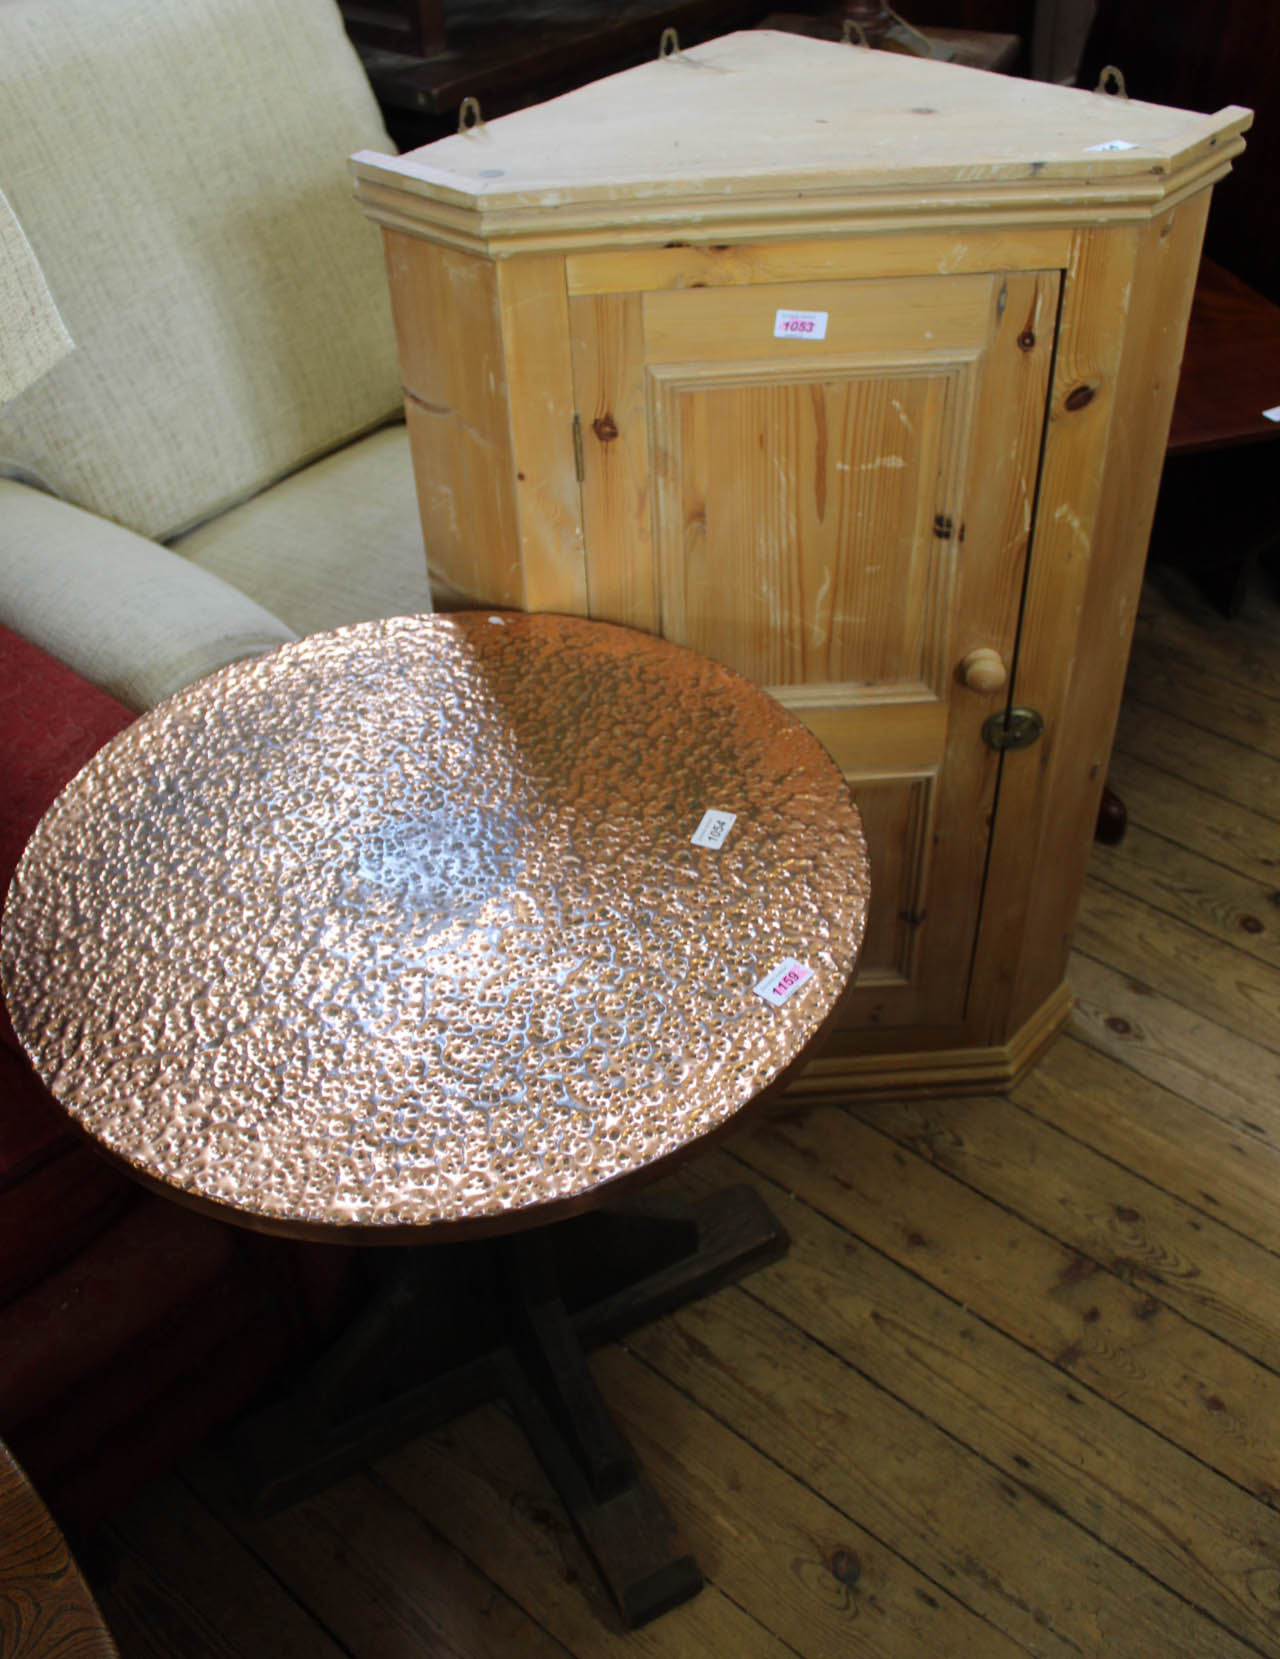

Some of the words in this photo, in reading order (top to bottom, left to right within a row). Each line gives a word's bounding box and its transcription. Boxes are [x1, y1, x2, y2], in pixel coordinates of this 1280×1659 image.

[783, 321, 815, 333] 1053
[708, 820, 726, 842] 1054
[773, 970, 799, 996] 1159
